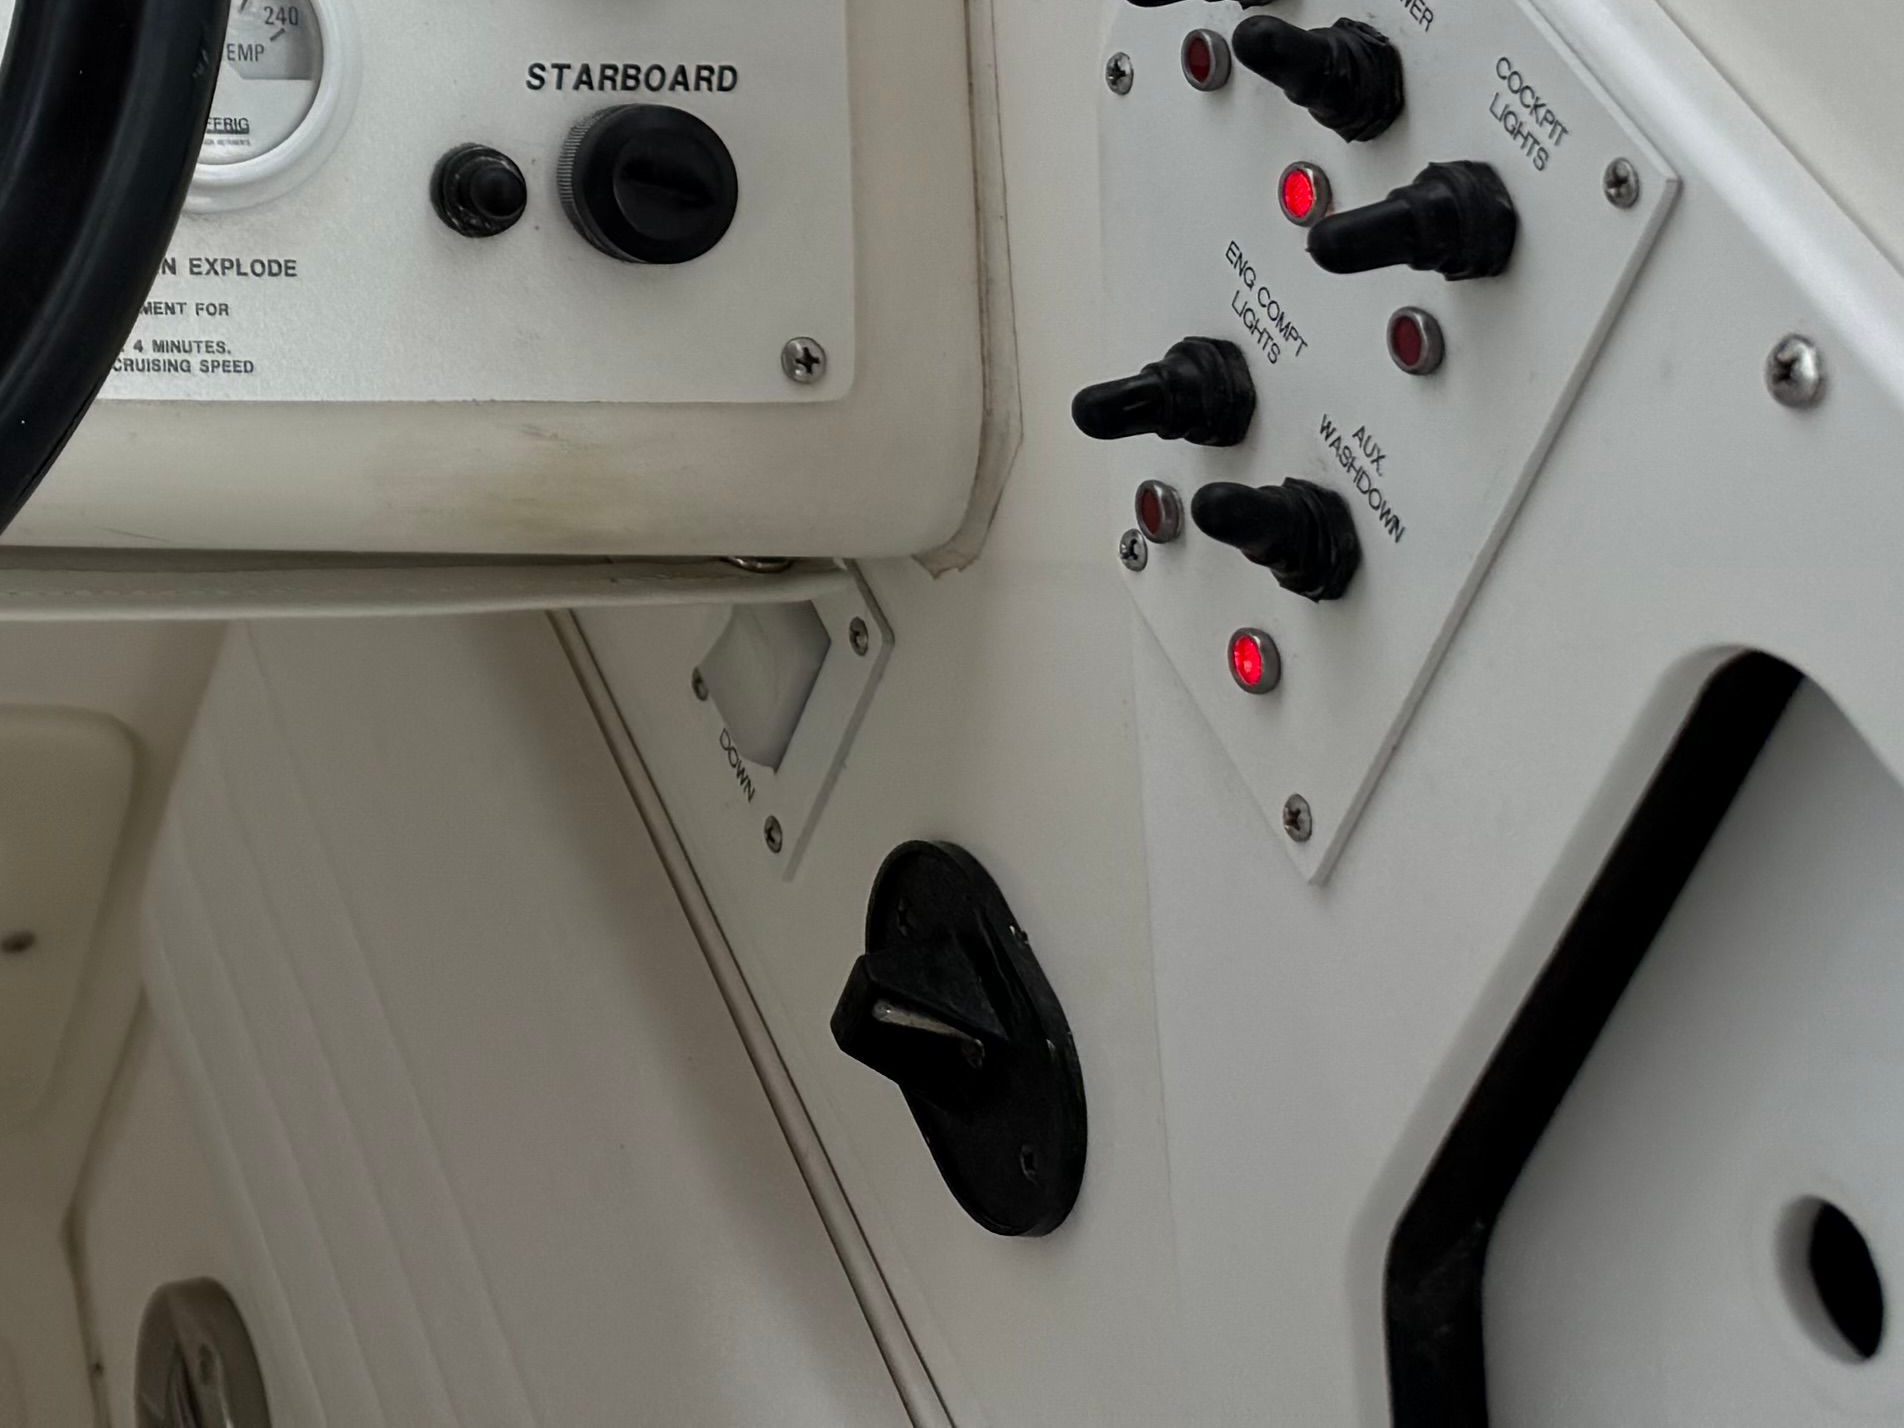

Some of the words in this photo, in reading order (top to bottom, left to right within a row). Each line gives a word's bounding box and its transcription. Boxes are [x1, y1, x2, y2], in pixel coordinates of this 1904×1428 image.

[264, 6, 299, 26] 240
[227, 43, 265, 62] EMP
[525, 62, 739, 93] STARBOARD
[1495, 56, 1569, 147] COCKPIT
[1489, 92, 1549, 172] LIGHTS
[189, 257, 298, 278] EXPLODE
[195, 302, 229, 317] FOR
[1225, 240, 1257, 290] ENG
[1257, 286, 1309, 359] COMPT
[1231, 290, 1282, 365] LIGHTS
[112, 358, 192, 374] CRUISING
[199, 359, 255, 374] SPEED
[1319, 413, 1407, 545] WASHDOWN
[719, 728, 755, 804] DOWN
